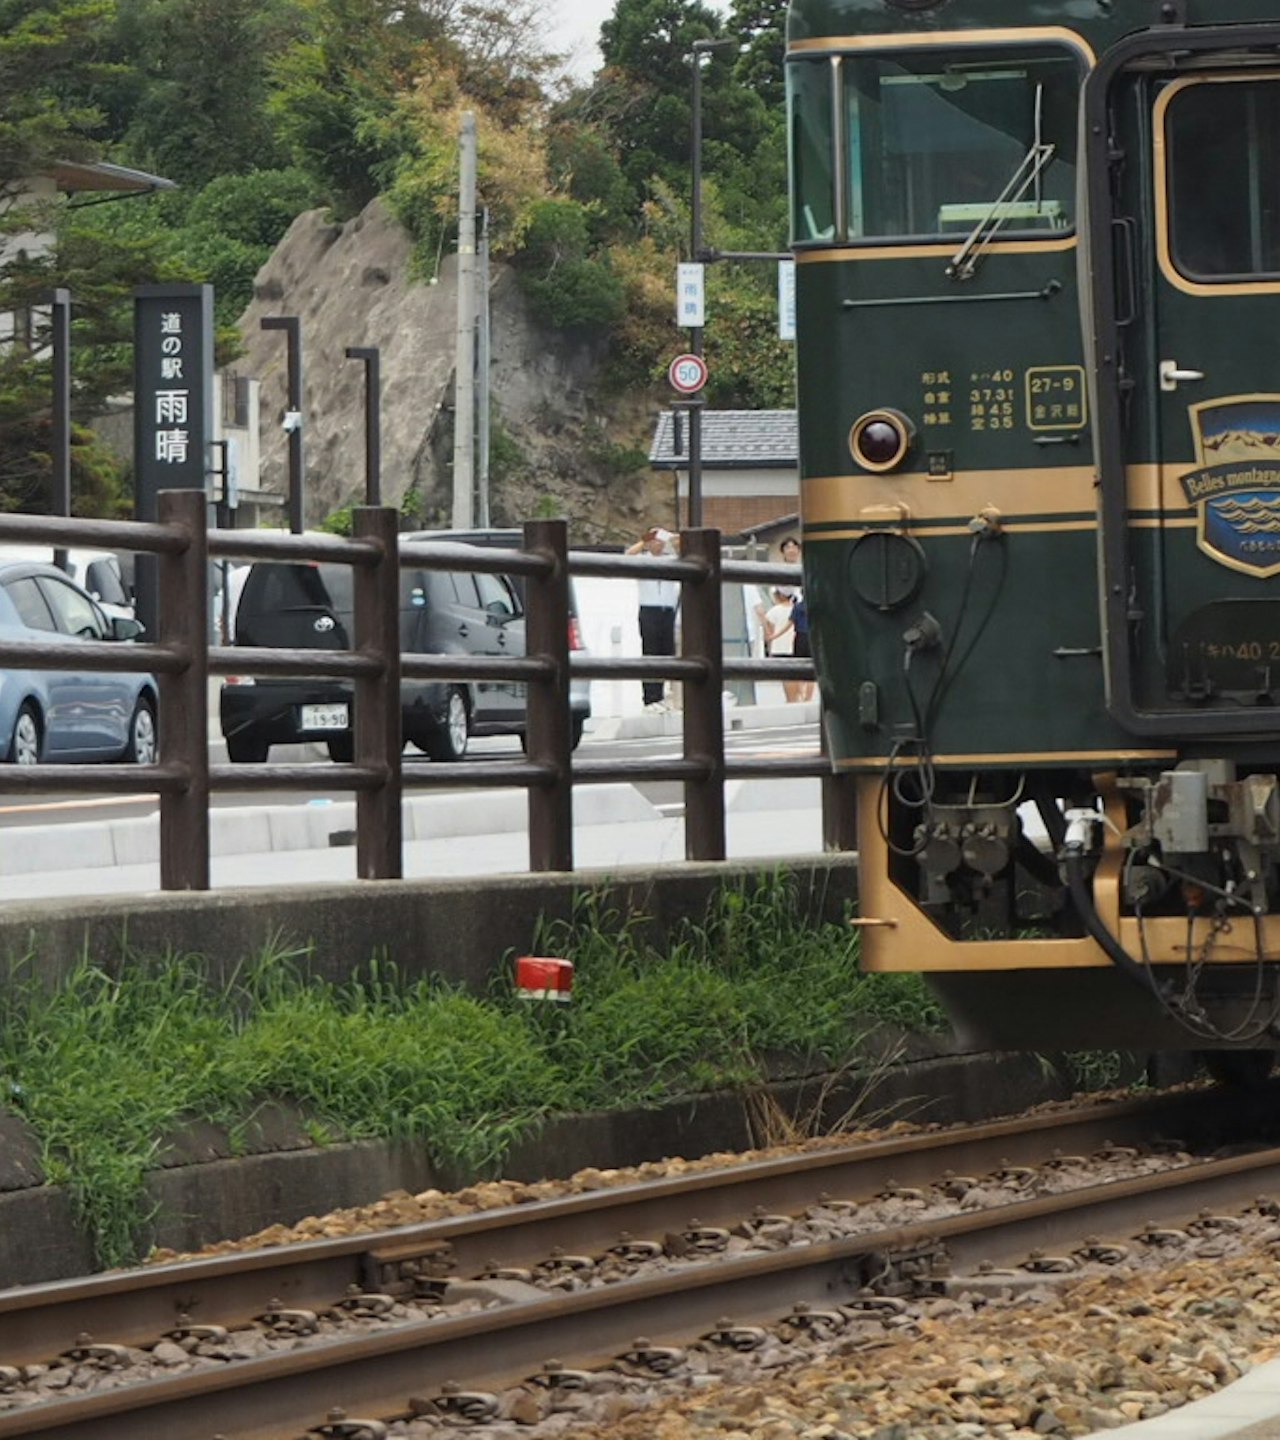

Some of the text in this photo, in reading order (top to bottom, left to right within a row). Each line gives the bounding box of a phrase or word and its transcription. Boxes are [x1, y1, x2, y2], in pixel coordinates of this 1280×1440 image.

[160, 313, 183, 380] 道の駅
[679, 365, 699, 381] 50
[1032, 378, 1074, 393] 27-9
[155, 389, 189, 464] 雨晴
[1187, 475, 1226, 497] Belles
